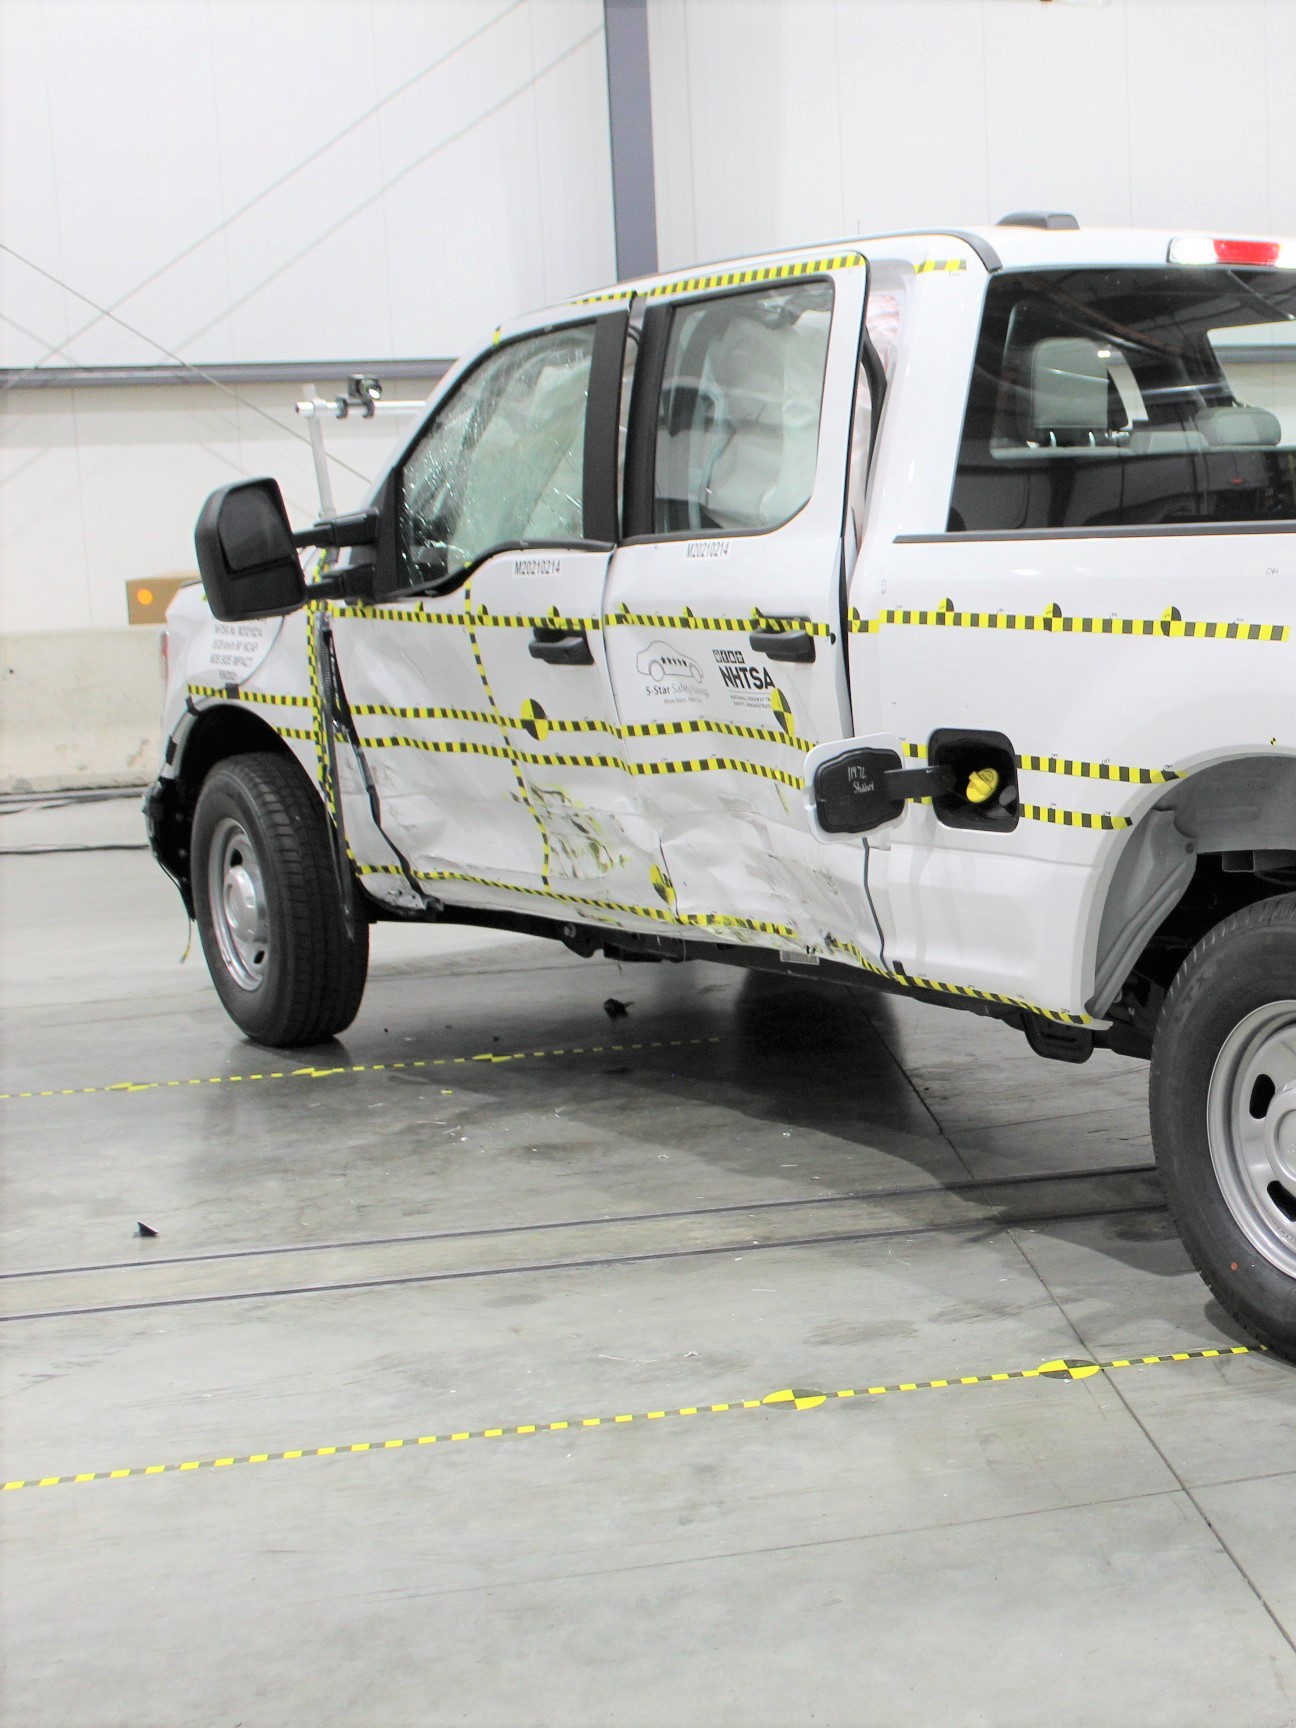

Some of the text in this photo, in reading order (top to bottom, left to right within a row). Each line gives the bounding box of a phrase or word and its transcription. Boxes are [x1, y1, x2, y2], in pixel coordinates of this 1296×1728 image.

[686, 541, 730, 558] M20210214
[514, 560, 561, 576] M20210214
[718, 665, 776, 690] NHTSA
